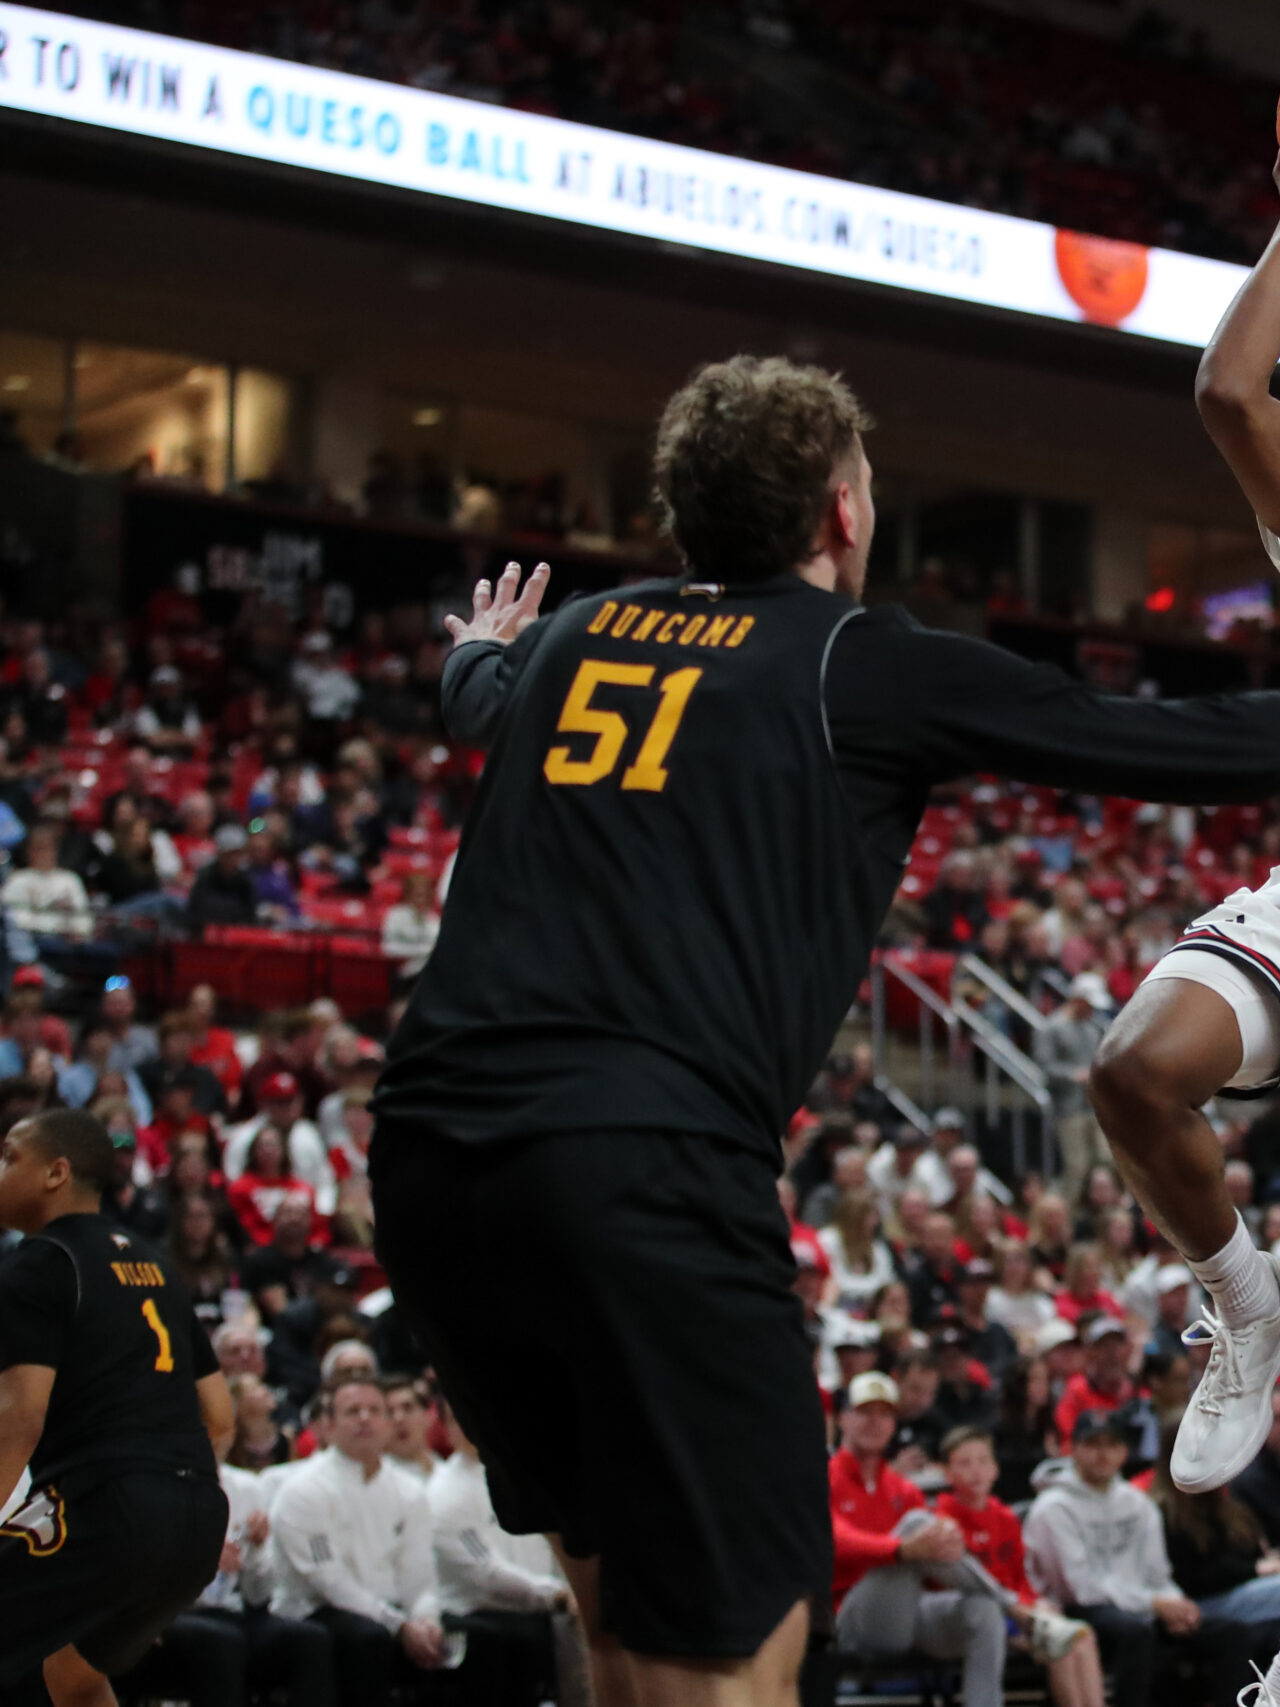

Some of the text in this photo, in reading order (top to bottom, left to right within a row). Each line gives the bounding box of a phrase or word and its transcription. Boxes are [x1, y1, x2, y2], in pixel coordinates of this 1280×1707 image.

[29, 33, 81, 92] TO
[101, 50, 185, 112] WIN
[199, 68, 225, 124] A
[245, 83, 402, 157] QUESO
[424, 120, 531, 184] BALL
[553, 148, 593, 197] AT
[586, 600, 756, 648] DUNCOMB
[543, 658, 704, 792] 51
[141, 1298, 174, 1373] 1
